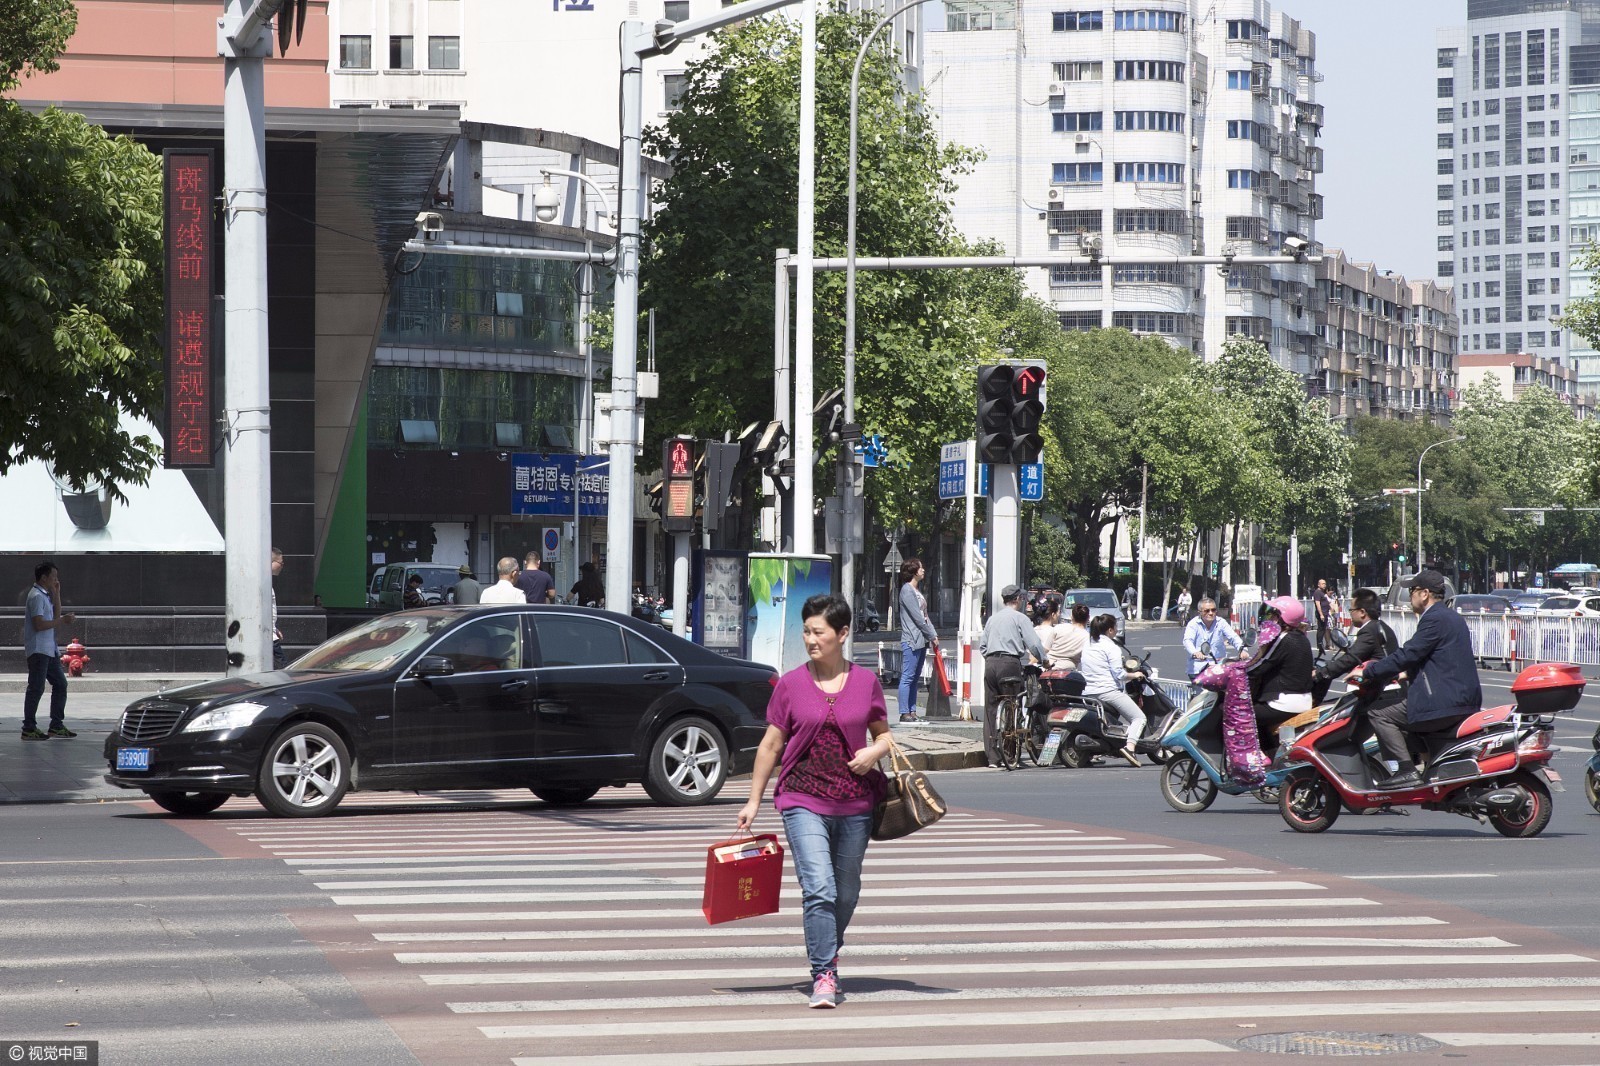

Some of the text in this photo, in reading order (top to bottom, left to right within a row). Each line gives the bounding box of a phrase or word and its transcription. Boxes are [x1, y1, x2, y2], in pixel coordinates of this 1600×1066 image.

[175, 167, 203, 281] 斑马线前
[176, 310, 204, 453] 请遵规守纪
[941, 463, 965, 478] 各行其道
[941, 479, 965, 495] 不闯红灯
